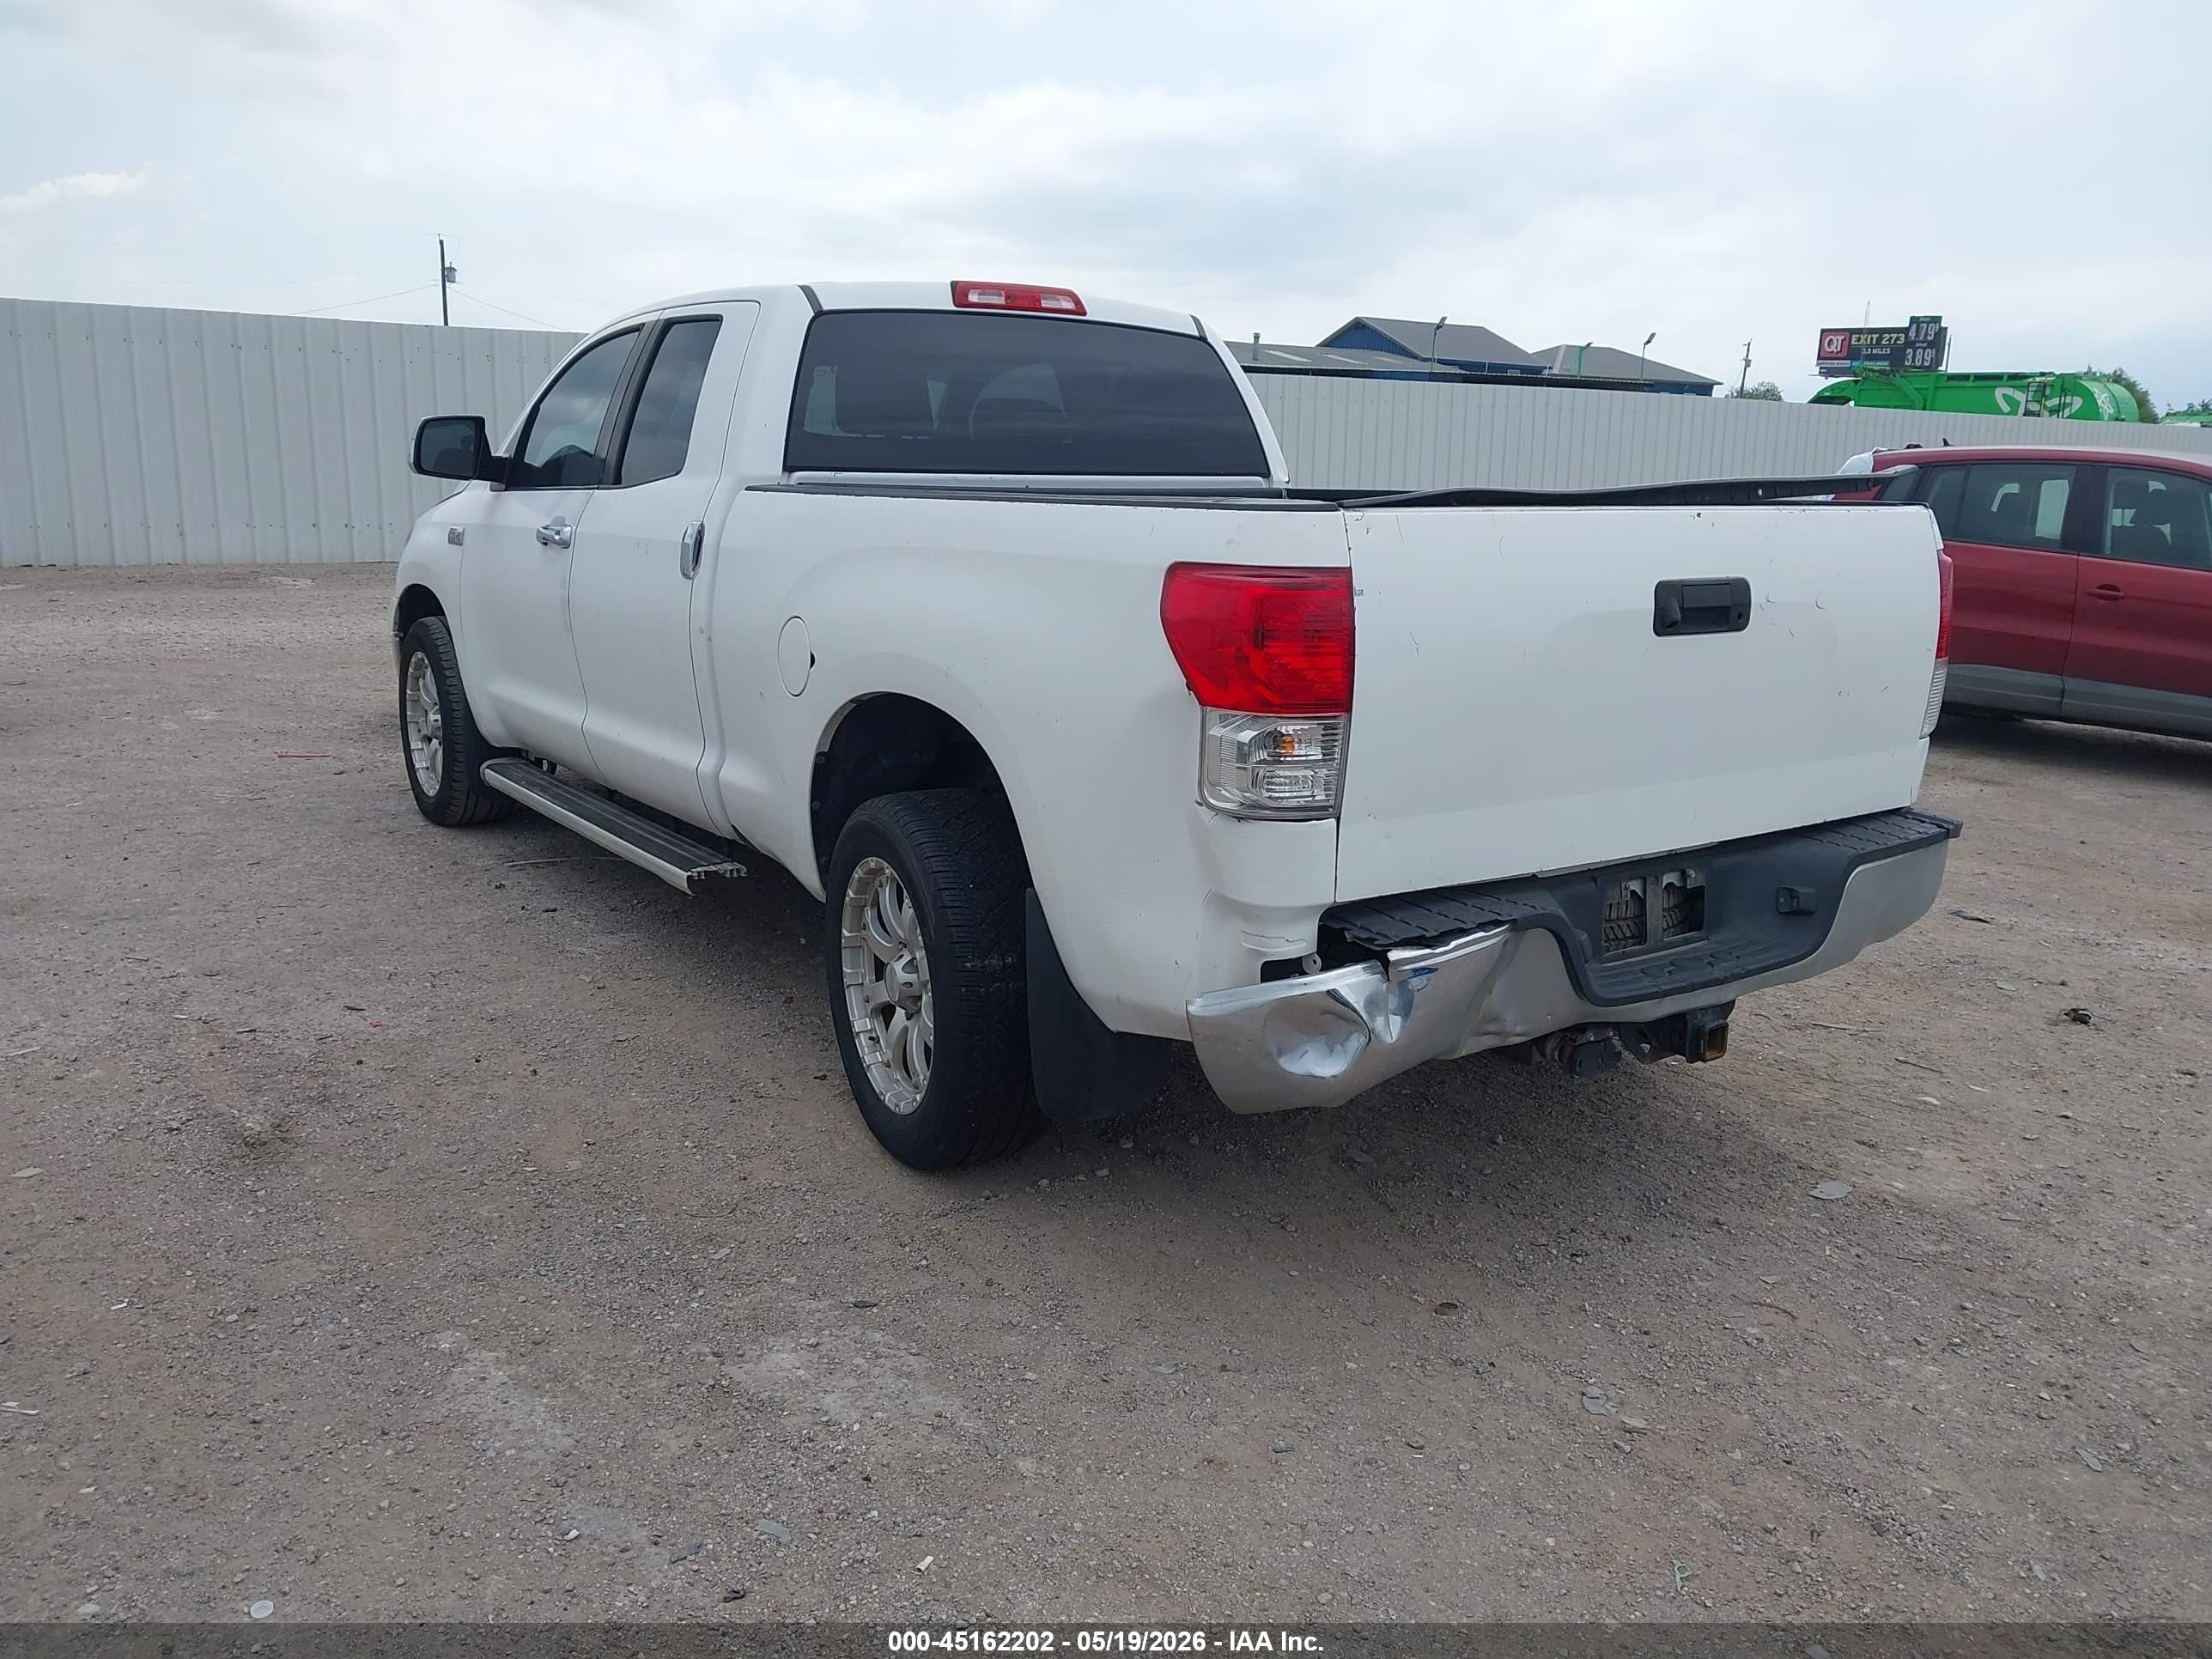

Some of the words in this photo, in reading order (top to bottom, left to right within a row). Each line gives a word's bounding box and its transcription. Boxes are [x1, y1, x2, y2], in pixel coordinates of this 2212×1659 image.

[1824, 335, 1844, 353] QT
[1851, 333, 1880, 345] EXIT
[1881, 333, 1905, 345] 273
